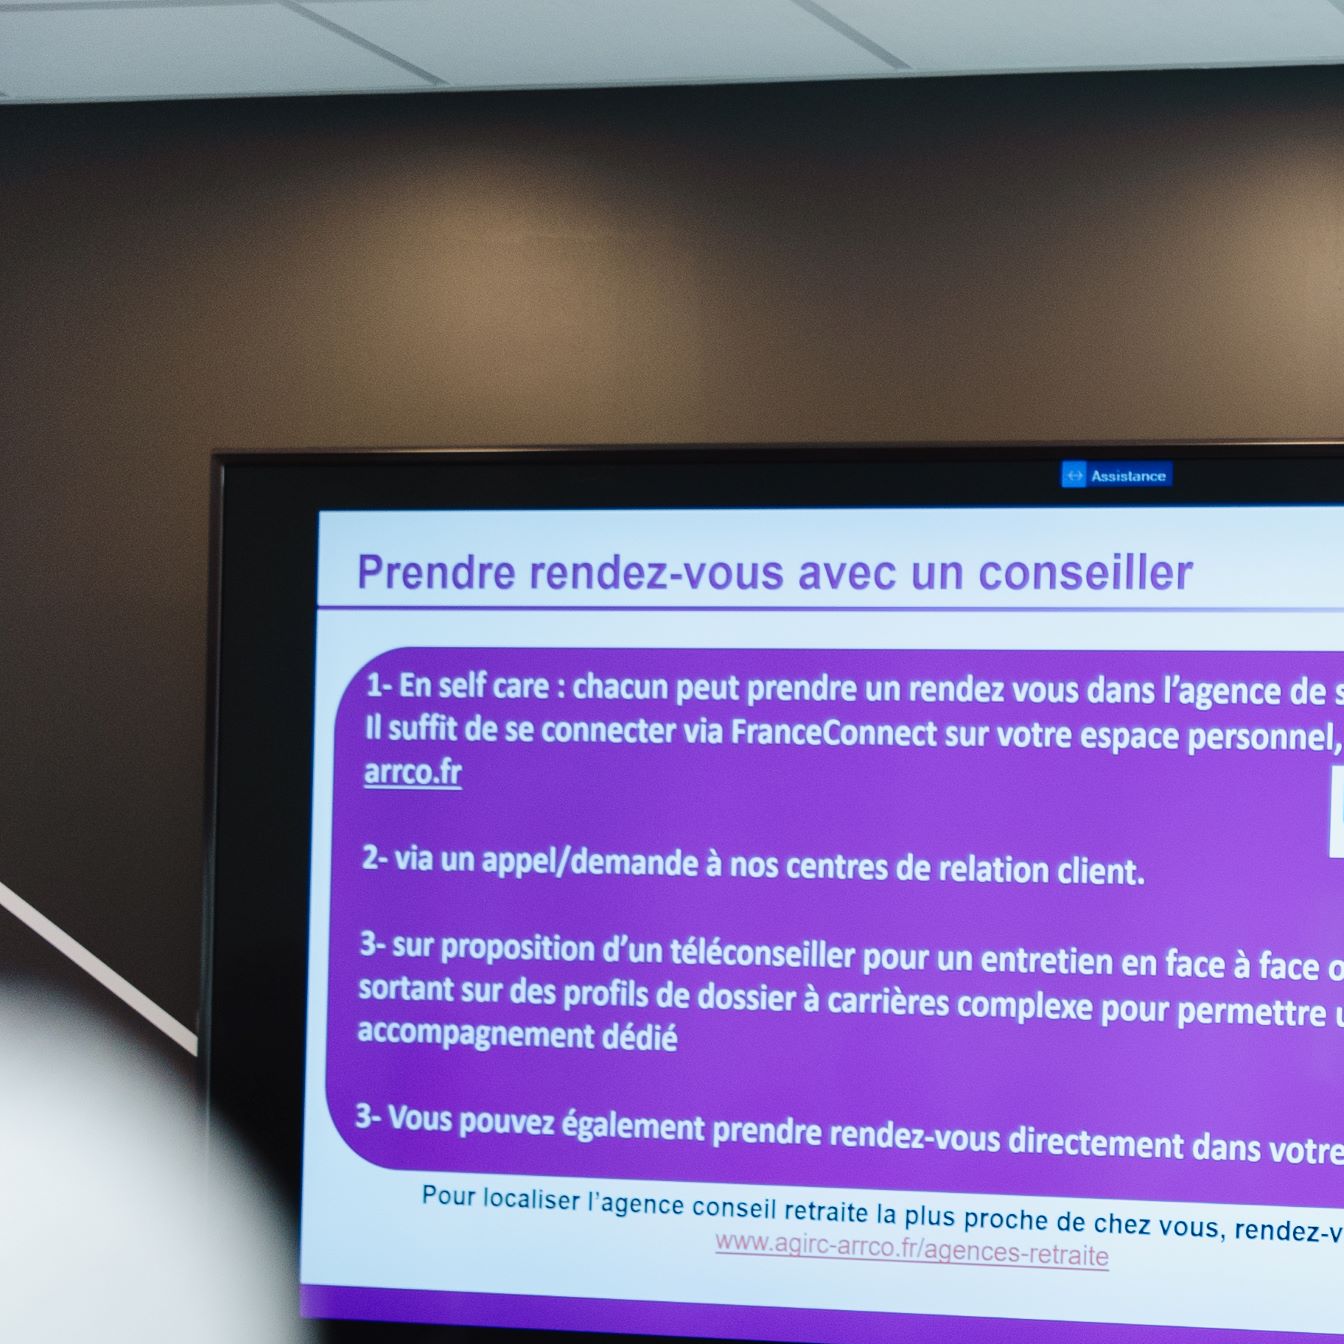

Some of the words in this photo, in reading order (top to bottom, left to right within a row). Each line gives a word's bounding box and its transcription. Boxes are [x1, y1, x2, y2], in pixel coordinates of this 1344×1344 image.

[1092, 470, 1166, 482] Assistance
[358, 553, 516, 590] Prendre
[530, 553, 784, 591] rendez-vous
[798, 561, 896, 591] avec
[912, 561, 963, 591] un
[979, 552, 1194, 591] conseiller
[367, 671, 393, 697] 1-
[399, 671, 432, 698] En
[438, 669, 488, 699] self
[492, 677, 550, 699] care
[572, 671, 668, 700] chacun
[676, 675, 740, 706] peut
[747, 672, 858, 707] prendre
[865, 680, 901, 702] un
[909, 673, 1005, 703] rendez
[1011, 681, 1080, 704] vous
[1086, 674, 1156, 704] dans
[1164, 674, 1282, 711] l’agence
[1289, 675, 1327, 706] de
[366, 712, 382, 740] Il
[388, 712, 458, 742] suffit
[464, 713, 499, 742] de
[504, 720, 535, 743] se
[541, 718, 678, 744] connecter
[683, 722, 723, 745] via
[731, 718, 938, 747] FranceConnect
[944, 725, 990, 747] sur
[996, 722, 1073, 749] votre
[1080, 726, 1180, 755] espace
[1188, 721, 1343, 756] personnel,
[363, 756, 463, 787] arrco.fr
[362, 843, 389, 870] 2-
[394, 843, 434, 871] via
[441, 850, 475, 872] un
[481, 844, 699, 880] appel/demande
[705, 847, 722, 877] à
[730, 856, 779, 879] nos
[786, 854, 889, 881] centres
[895, 852, 931, 882] de
[939, 853, 1049, 884] relation
[1057, 855, 1145, 886] client.
[359, 929, 387, 957] 3-
[392, 935, 435, 958] sur
[441, 933, 595, 966] proposition
[602, 934, 663, 964] d’un
[669, 935, 857, 969] téléconseiller
[863, 947, 930, 976] pour
[937, 950, 973, 972] un
[980, 946, 1113, 975] entretien
[1121, 954, 1157, 976] en
[1165, 947, 1226, 979] face
[1233, 948, 1251, 979] à
[1258, 949, 1320, 981] face
[358, 975, 455, 1002] sortant
[461, 981, 504, 1003] sur
[509, 975, 557, 1005] des
[563, 977, 649, 1012] profils
[655, 980, 691, 1009] de
[697, 981, 797, 1012] dossier
[803, 983, 820, 1013] à
[827, 985, 950, 1017] carrières
[957, 990, 1094, 1025] complexe
[1101, 999, 1171, 1027] pour
[1177, 1000, 1327, 1030] permettre
[357, 1020, 596, 1052] accompagnement
[601, 1021, 678, 1052] dédié
[355, 1102, 382, 1129] 3-
[387, 1103, 453, 1132] Vous
[459, 1111, 555, 1138] pouvez
[561, 1107, 706, 1143] également
[712, 1116, 823, 1148] prendre
[830, 1120, 1001, 1153] rendez-vous
[1008, 1125, 1185, 1160] directement
[1192, 1131, 1261, 1163] dans
[423, 1184, 477, 1206] Pour
[484, 1187, 581, 1211] localiser
[588, 1191, 684, 1218] l’agence
[692, 1198, 776, 1219] conseil
[785, 1201, 868, 1223] retraite
[877, 1203, 896, 1224] la
[905, 1204, 955, 1230] plus
[964, 1209, 1048, 1233] proche
[1057, 1211, 1085, 1232] de
[1094, 1212, 1151, 1235] chez
[1159, 1219, 1225, 1242] vous,
[714, 1231, 1110, 1269] www.agirc-arrco.fr/agences-retraite
